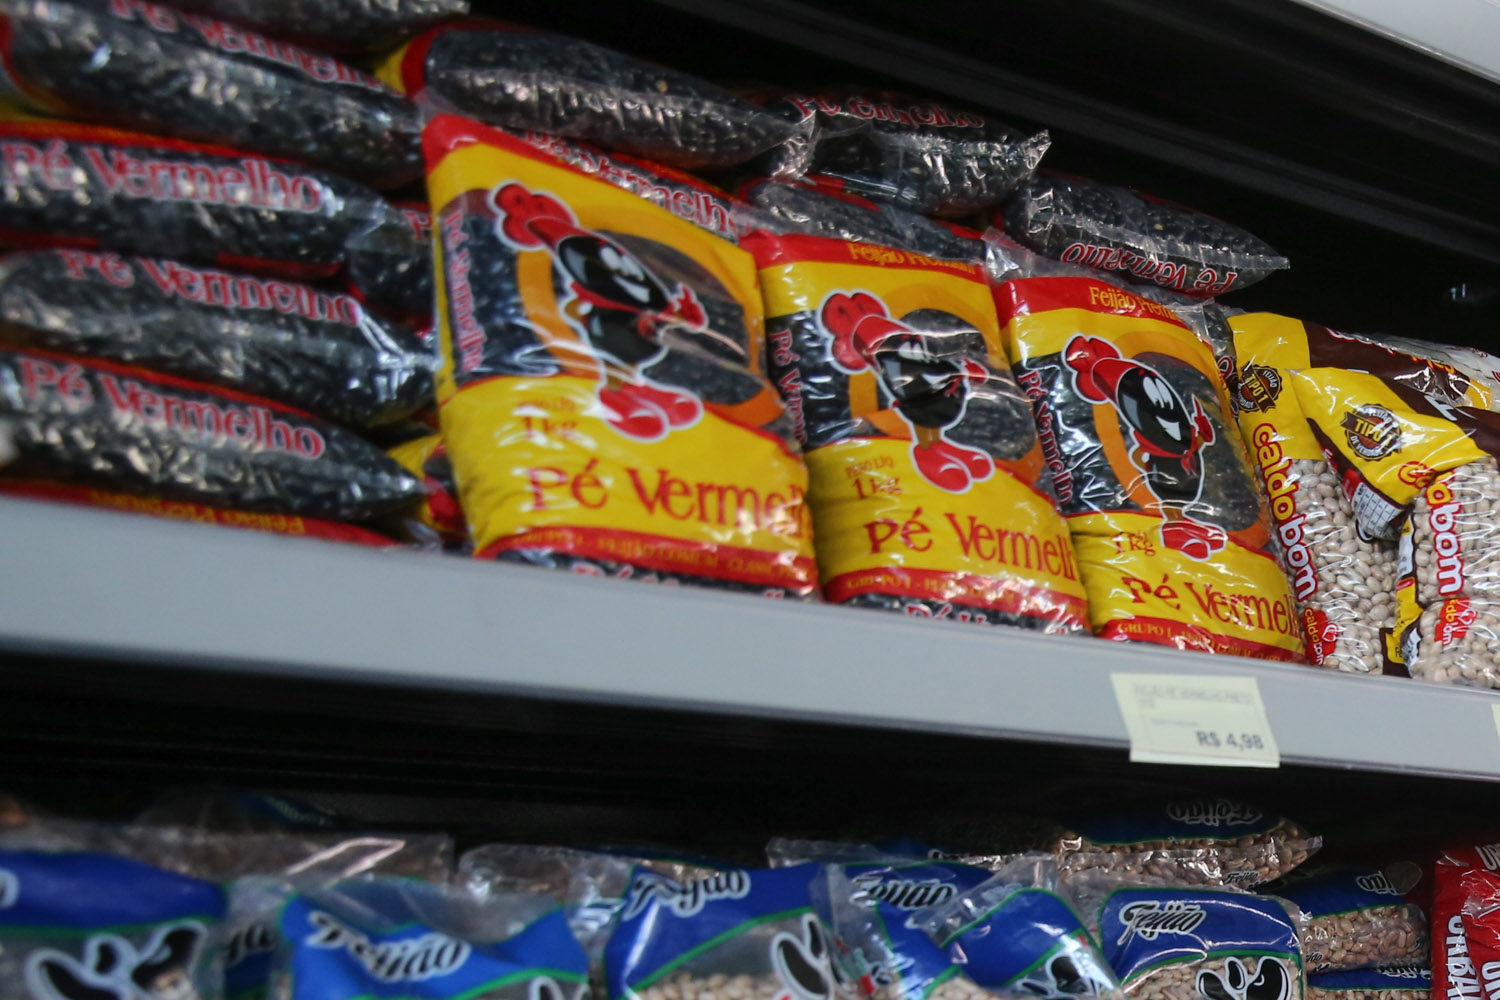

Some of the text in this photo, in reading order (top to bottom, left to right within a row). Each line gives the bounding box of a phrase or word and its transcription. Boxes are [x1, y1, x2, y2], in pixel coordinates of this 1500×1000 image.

[83, 143, 325, 213] Vermelho
[1089, 286, 1137, 315] Feijão
[1245, 373, 1263, 396] TIPO
[98, 373, 327, 460] Vermelho
[527, 458, 610, 512] Pé
[864, 506, 933, 553] Pé
[1122, 573, 1181, 610] Pé
[1226, 732, 1265, 752] 4,98
[1118, 900, 1207, 940] Feijão
